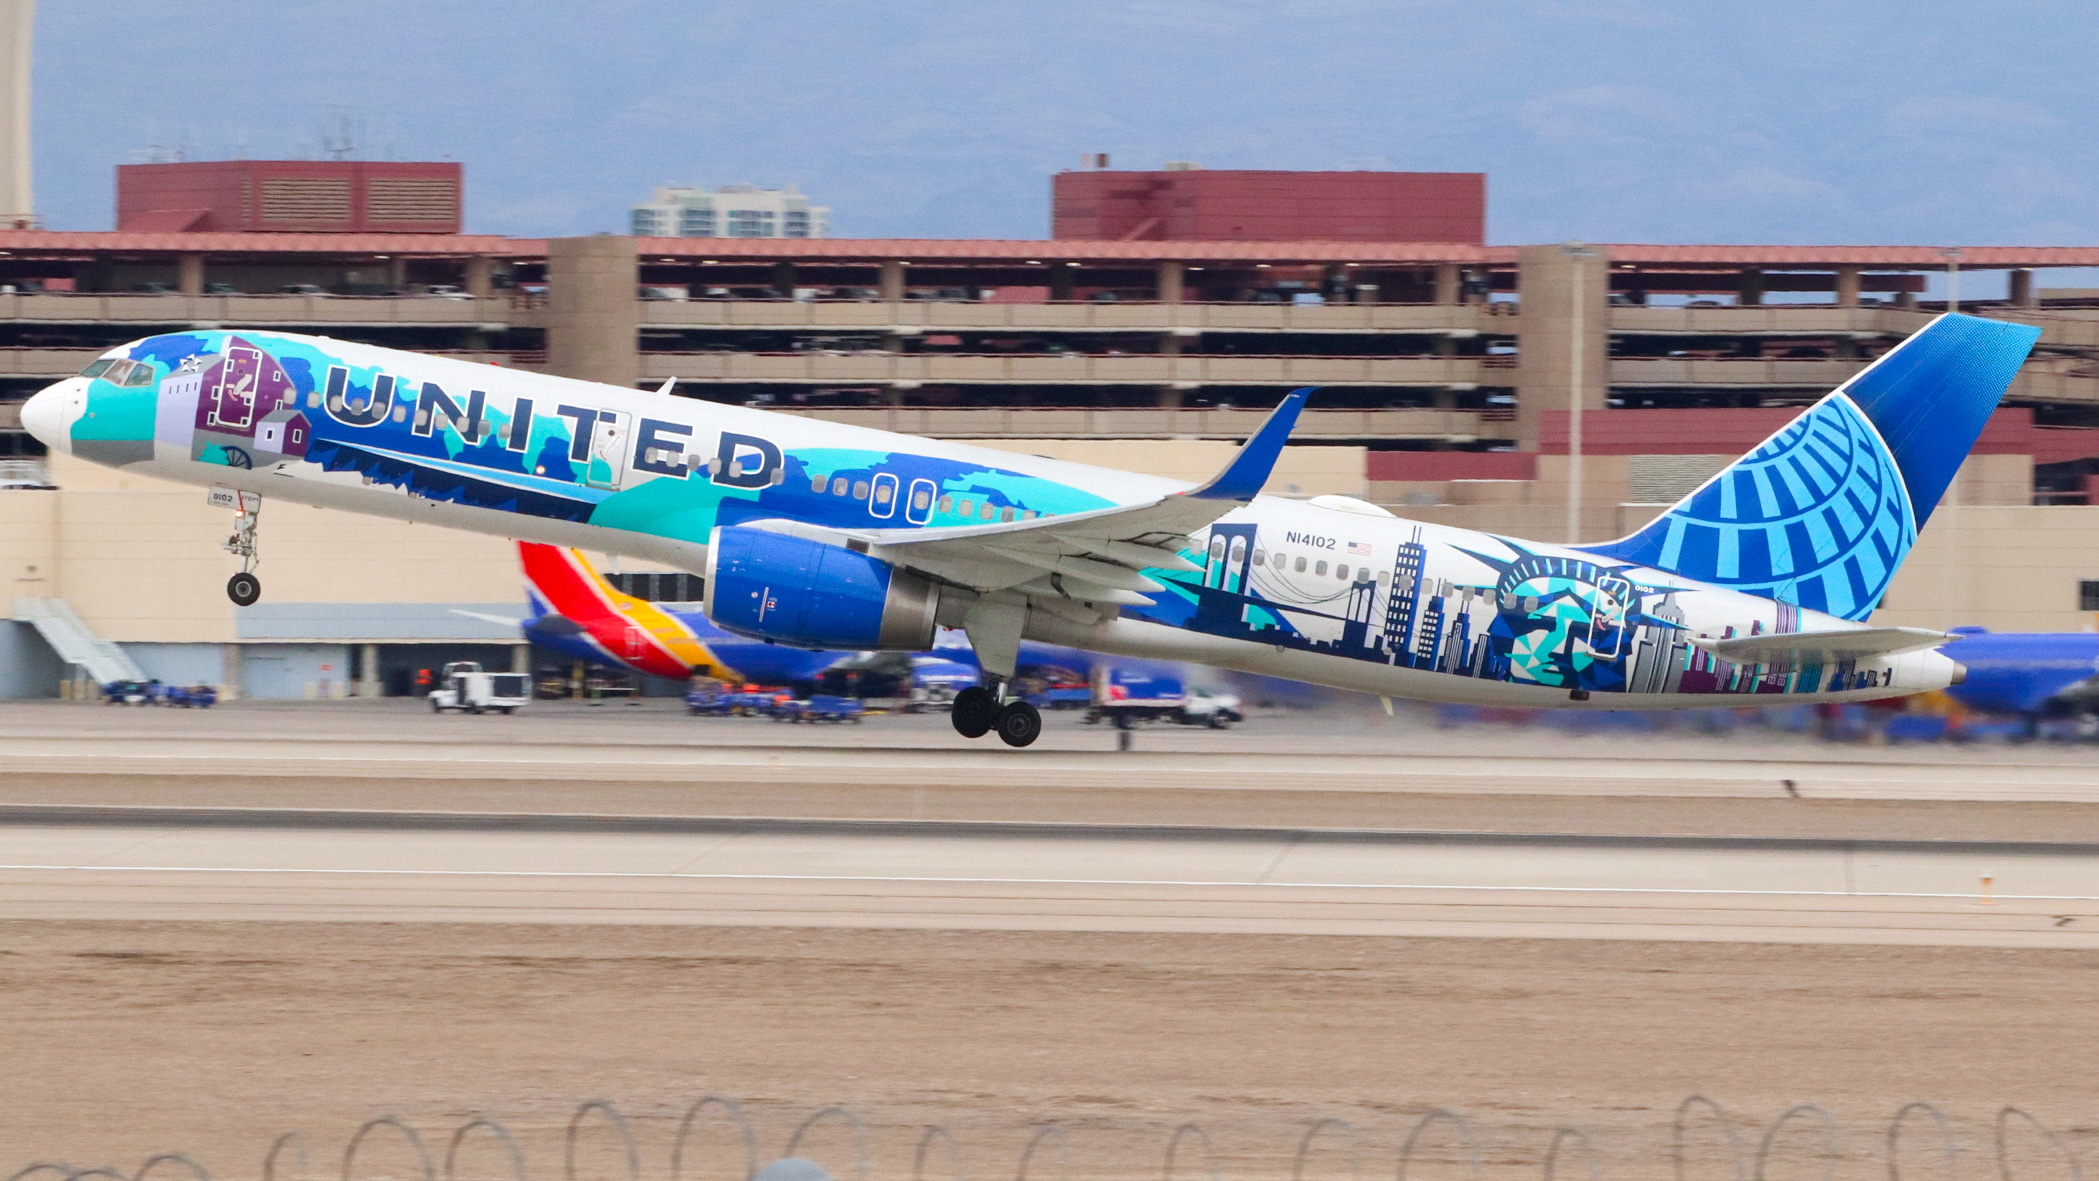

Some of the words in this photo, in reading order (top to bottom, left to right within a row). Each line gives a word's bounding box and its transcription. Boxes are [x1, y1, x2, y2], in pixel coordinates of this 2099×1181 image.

[324, 365, 785, 490] UNITED
[213, 493, 233, 502] 0102
[1286, 531, 1336, 550] N14102
[1635, 584, 1655, 594] 0102
